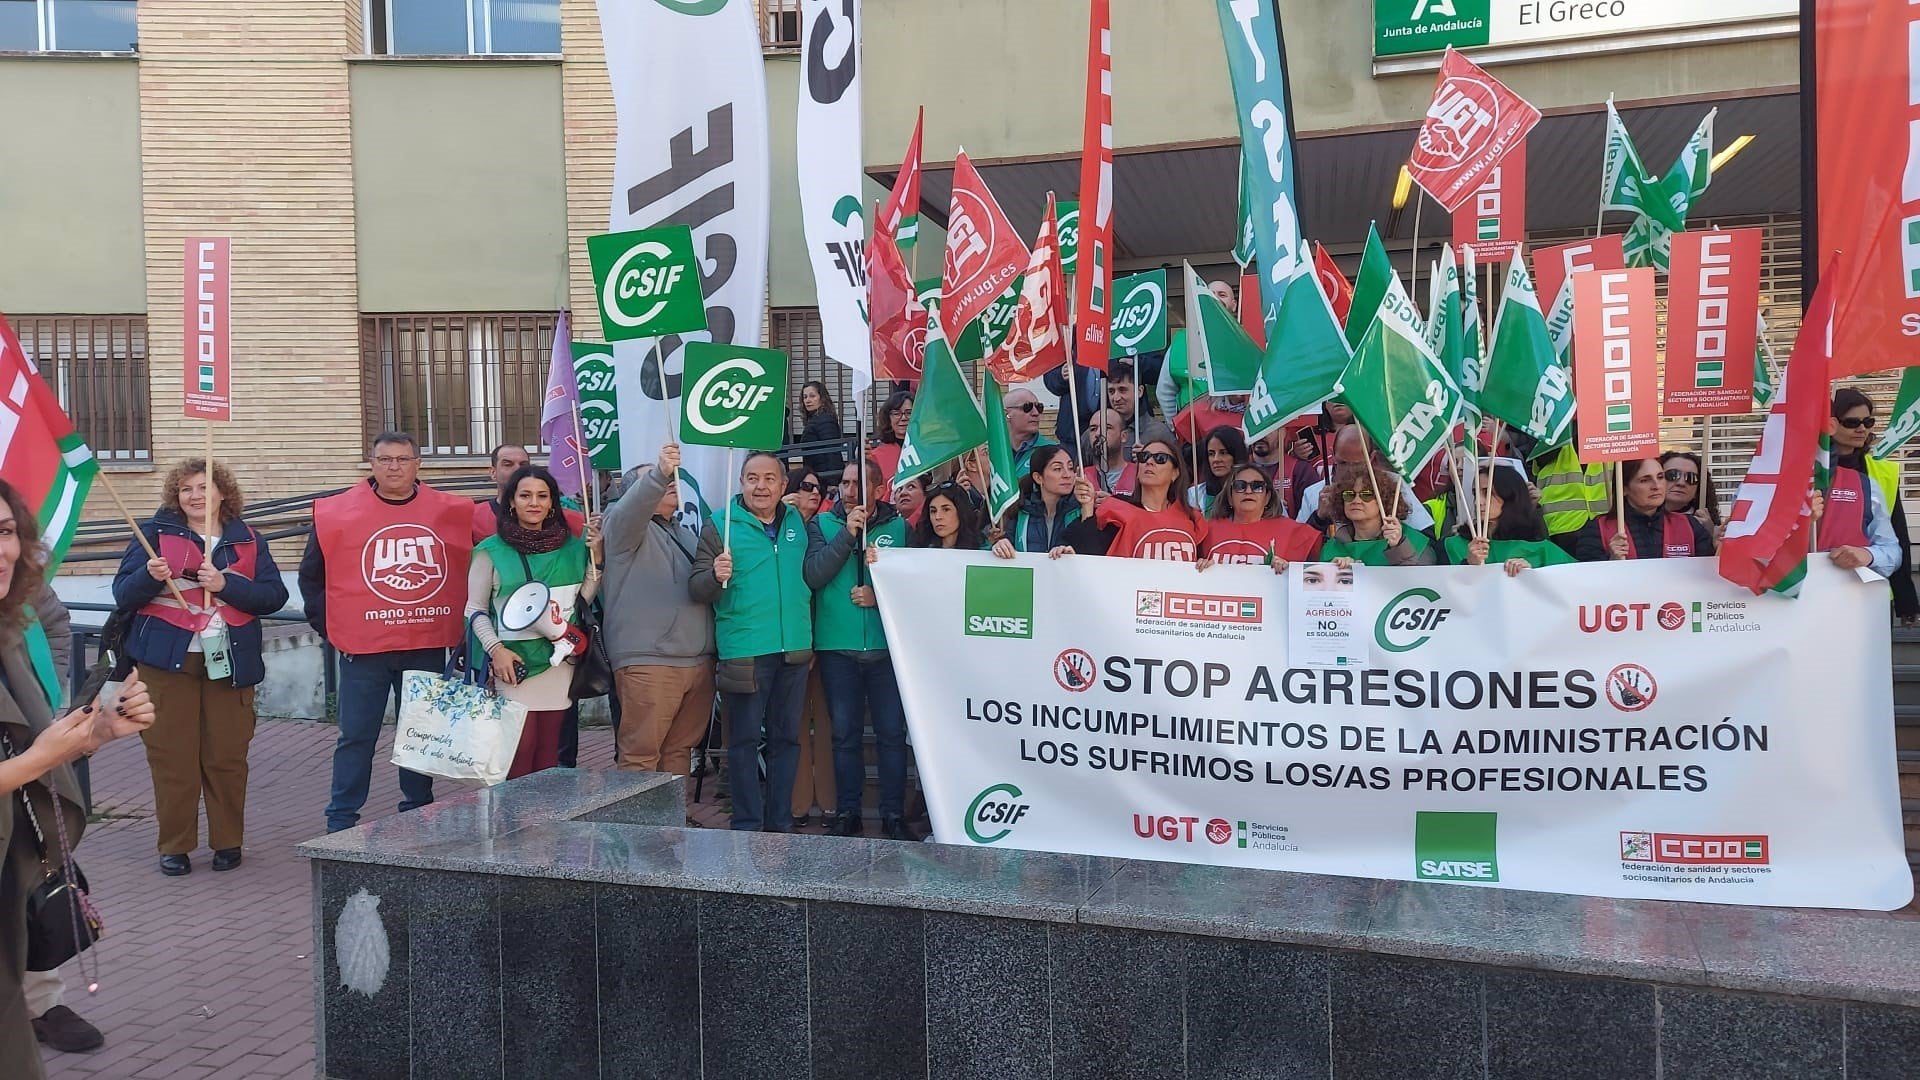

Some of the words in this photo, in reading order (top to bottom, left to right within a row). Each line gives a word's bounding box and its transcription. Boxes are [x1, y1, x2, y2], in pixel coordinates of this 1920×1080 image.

[1519, 3, 1541, 25] El
[1549, 0, 1625, 22] Greco
[1383, 26, 1413, 38] Junta
[1414, 24, 1428, 34] de
[1429, 17, 1482, 33] Andalucía
[1426, 82, 1493, 147] UGT
[198, 242, 215, 362] CCOO
[951, 261, 1017, 327] www.ugt.es
[1696, 234, 1732, 358] CCOO
[1600, 273, 1632, 401] CCOO
[374, 536, 436, 570] UGT
[365, 608, 405, 620] mano
[414, 606, 451, 616] mano
[1169, 597, 1240, 618] CCOO
[1305, 608, 1352, 617] AGRESIÓN
[1706, 602, 1746, 610] Servicios
[1706, 611, 1745, 620] Públicos
[968, 614, 1029, 635] SATSE
[1135, 618, 1170, 627] federación
[1172, 620, 1187, 628] de
[1189, 621, 1220, 630] sanidad
[1228, 624, 1263, 632] sectores
[1318, 620, 1337, 631] NO
[1578, 602, 1651, 634] UGT
[1708, 621, 1761, 632] Andalucía
[1135, 628, 1194, 637] sociosanitarios
[1103, 655, 1231, 698] STOP
[1245, 665, 1598, 710] AGRESIONES
[965, 697, 1023, 726] LOS
[1031, 703, 1329, 750] INCUMPLIMIENTOS
[1340, 725, 1386, 753] DE
[1398, 728, 1443, 755] LA
[1451, 716, 1769, 755] ADMINISTRACIÓN
[1020, 738, 1079, 767] LOS
[1088, 745, 1254, 784] SUFRIMOS
[1265, 760, 1391, 791] LOS/AS
[1403, 764, 1709, 793] PROFESIONALES
[1133, 813, 1200, 843] UGT
[1251, 822, 1289, 833] Servicios
[1251, 831, 1286, 841] Públicos
[1252, 841, 1299, 852] Andalucía
[1660, 839, 1742, 859] CCOO
[1420, 860, 1493, 879] SATSE
[1621, 861, 1673, 872] federación
[1674, 864, 1685, 873] de
[1687, 865, 1722, 873] sanidad
[1723, 867, 1729, 875] y
[1731, 866, 1772, 874] sectores
[1622, 873, 1692, 883] sociosanitarios
[1694, 875, 1705, 883] de
